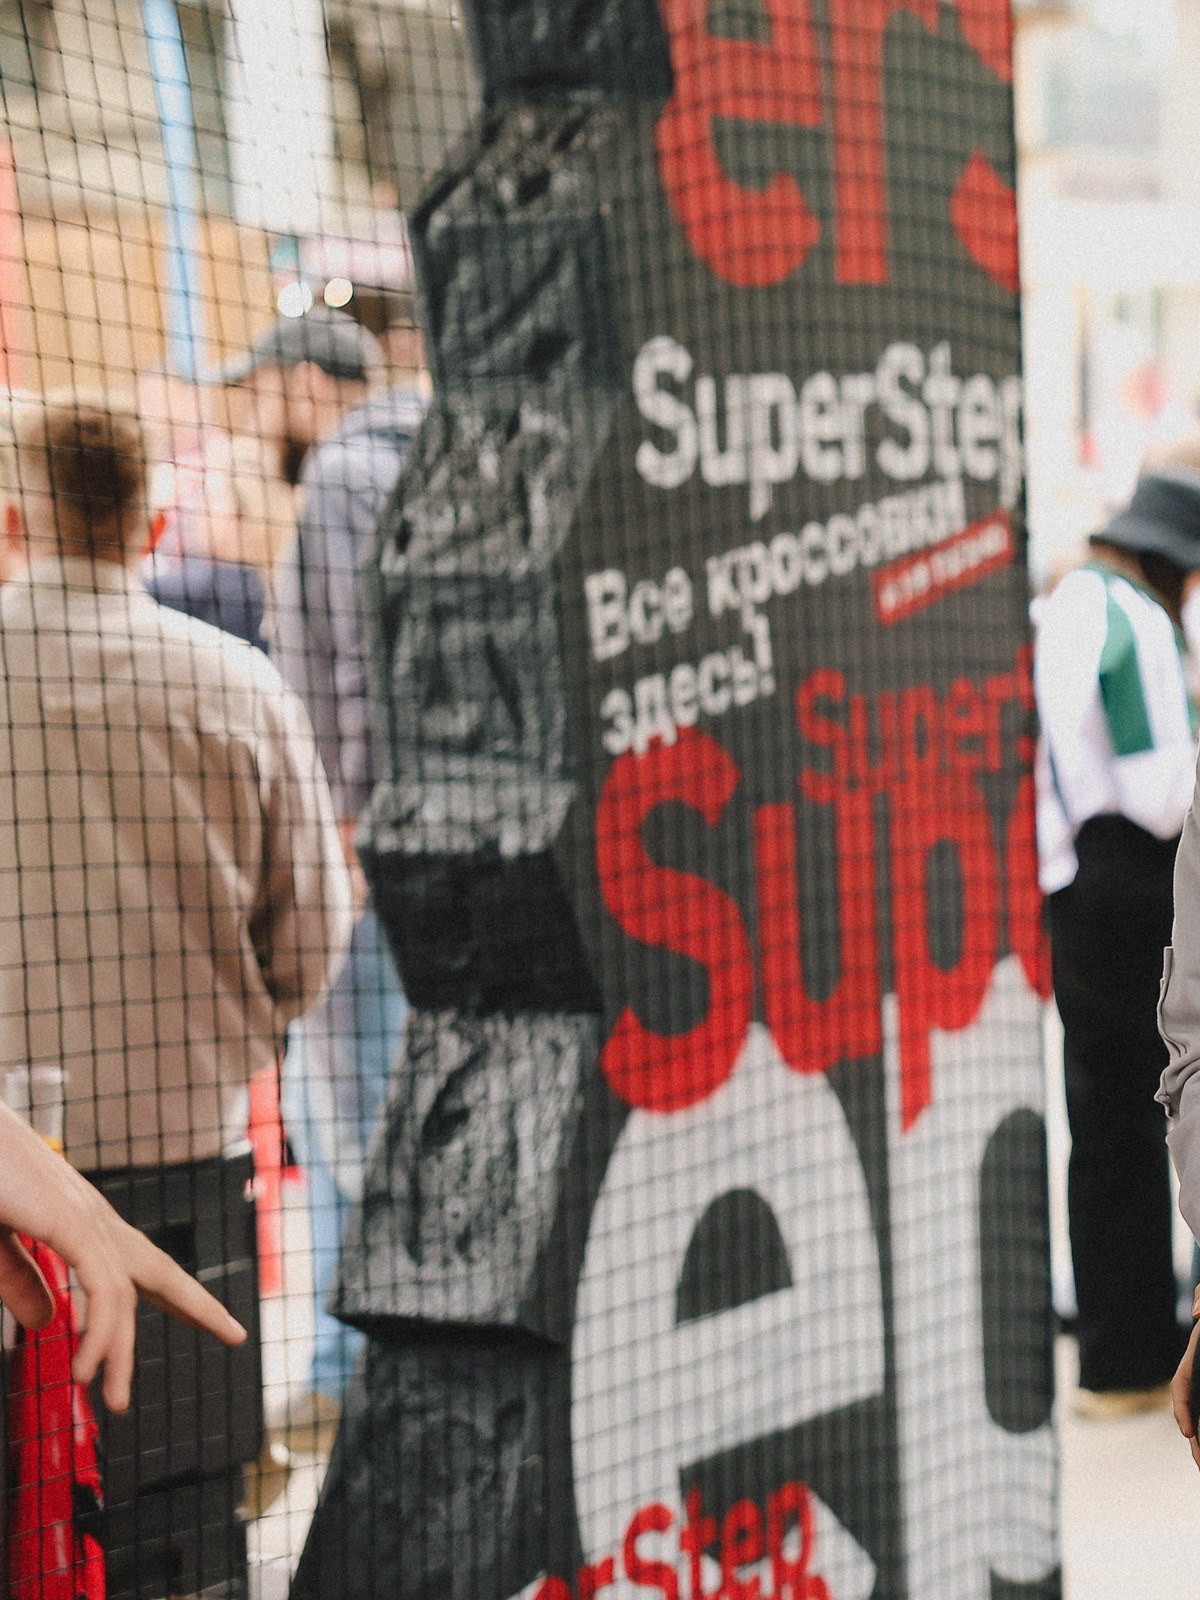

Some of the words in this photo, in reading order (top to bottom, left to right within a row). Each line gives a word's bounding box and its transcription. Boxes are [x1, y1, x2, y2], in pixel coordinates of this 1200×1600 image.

[584, 567, 694, 661] Все
[706, 482, 967, 634] кроссовки
[600, 611, 776, 757] здесь!
